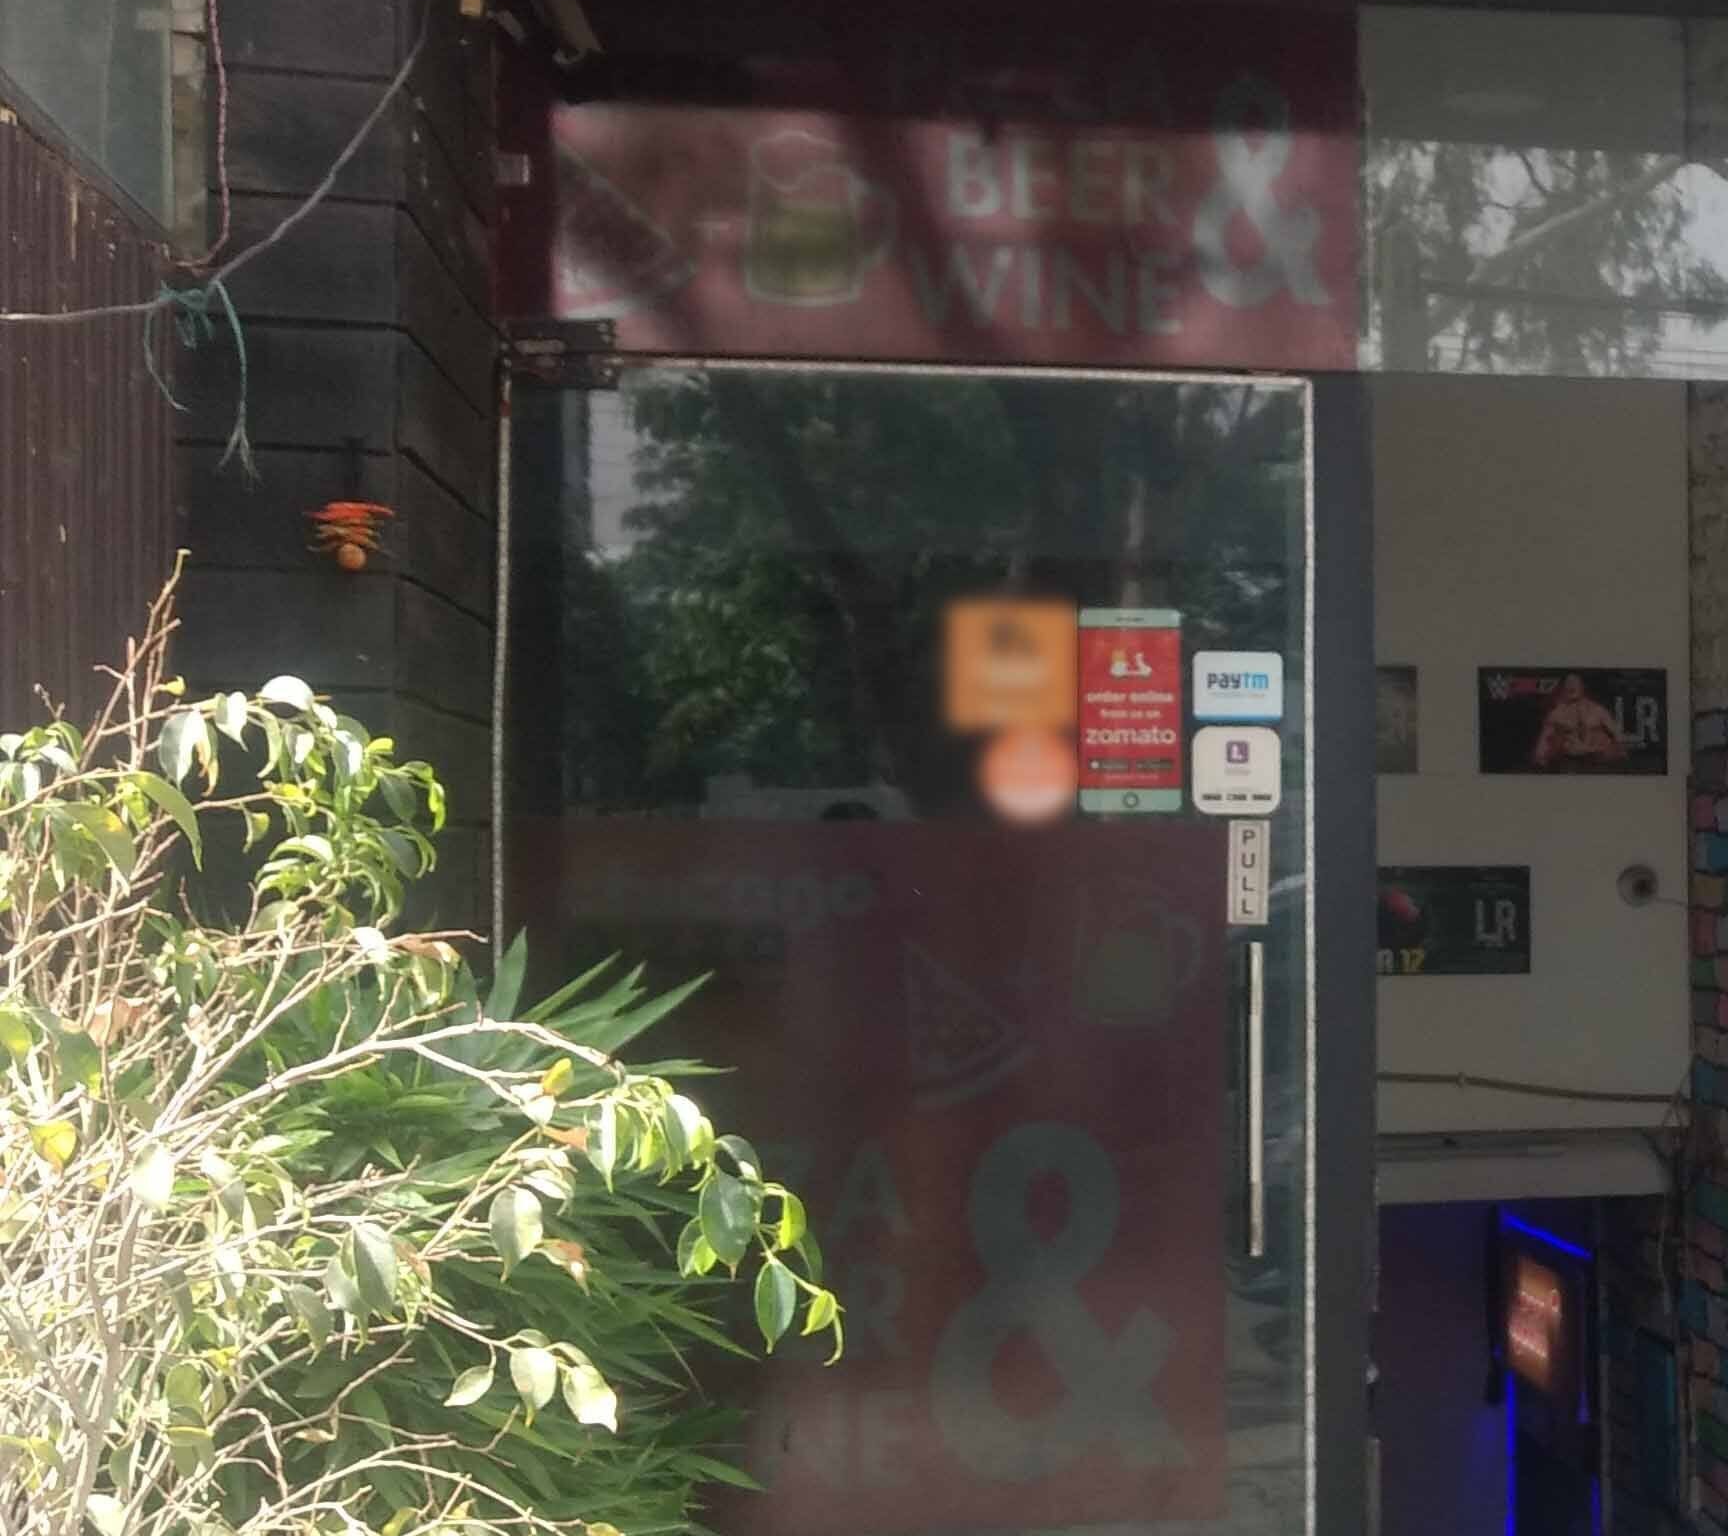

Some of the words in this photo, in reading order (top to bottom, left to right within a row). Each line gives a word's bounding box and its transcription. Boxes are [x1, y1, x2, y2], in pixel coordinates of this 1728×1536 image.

[945, 132, 1178, 226] BEER
[914, 242, 1183, 335] WINE
[1085, 726, 1177, 745] zomato
[1241, 828, 1257, 916] PULL
